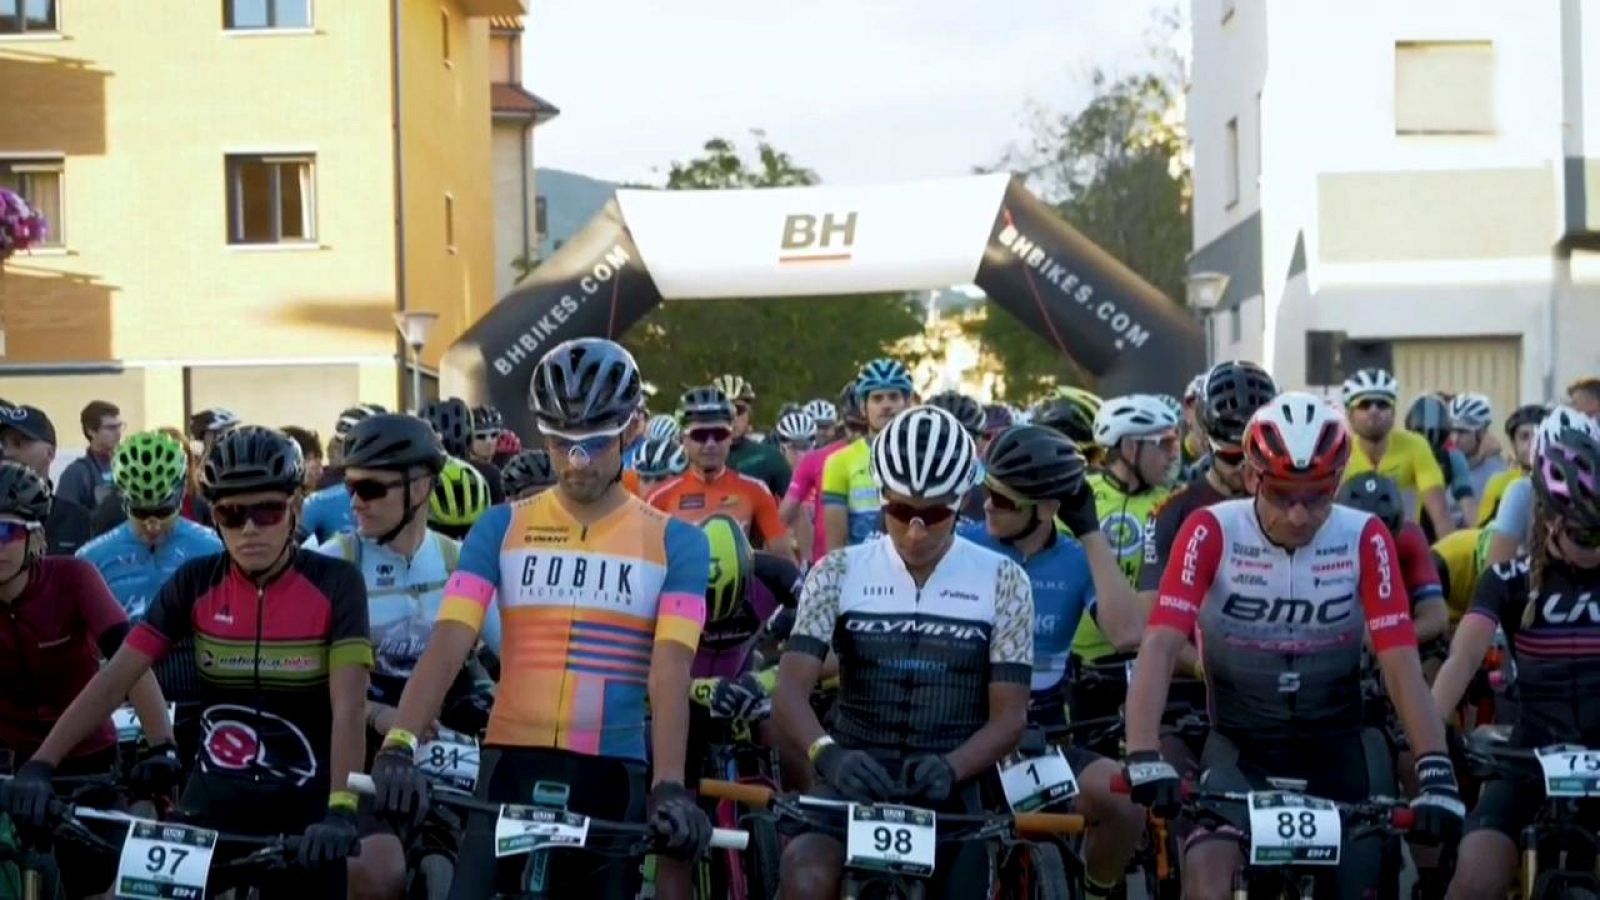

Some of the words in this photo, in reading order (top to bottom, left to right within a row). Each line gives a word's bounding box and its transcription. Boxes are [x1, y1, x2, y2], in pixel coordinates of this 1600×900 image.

[780, 211, 859, 250] BH
[998, 224, 1150, 348] BHBIKES.COM
[494, 244, 631, 376] BHBIKES.COM
[521, 555, 633, 596] GOBIK
[1222, 593, 1354, 625] BMC
[845, 619, 988, 641] OLYMPIA
[430, 744, 459, 770] 81
[1562, 754, 1600, 771] 75
[1025, 763, 1041, 786] 1
[1277, 811, 1317, 839] 88
[873, 826, 912, 855] 98
[145, 845, 190, 875] 97
